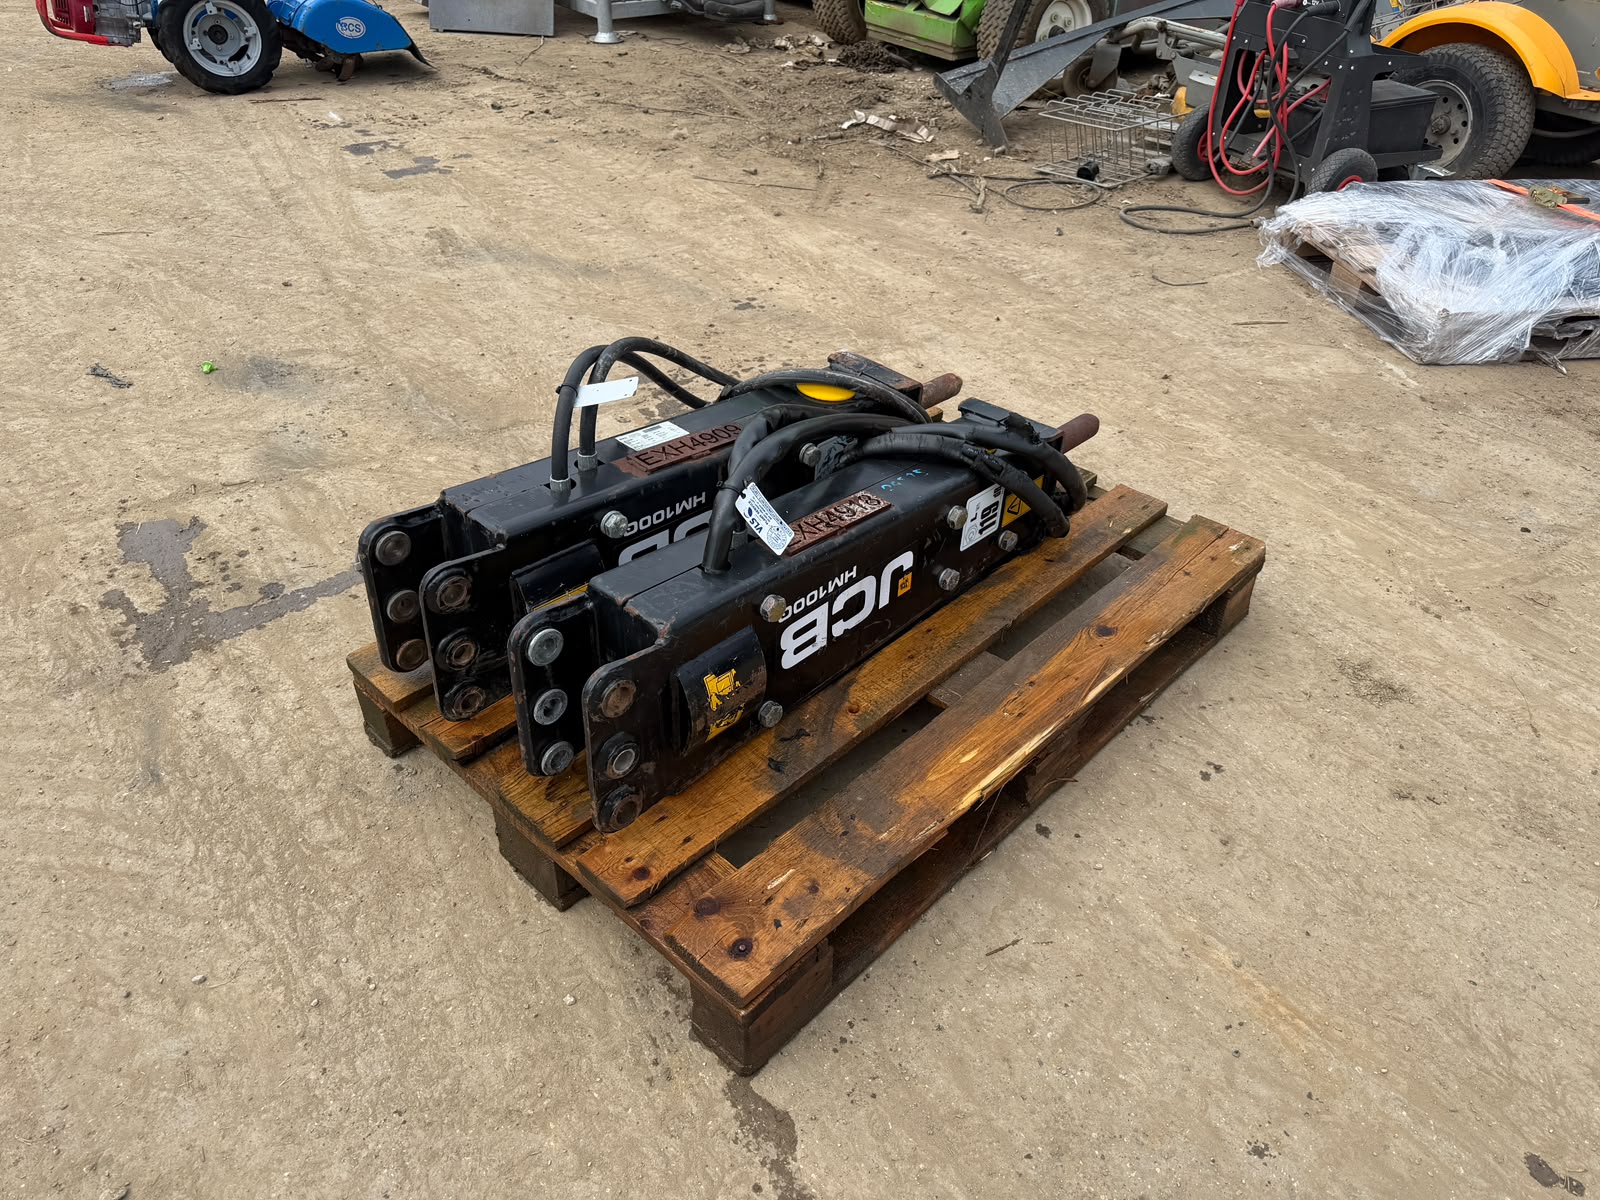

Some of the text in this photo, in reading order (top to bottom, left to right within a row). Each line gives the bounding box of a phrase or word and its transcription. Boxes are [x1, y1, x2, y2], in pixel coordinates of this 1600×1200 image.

[340, 22, 361, 33] BCS
[635, 424, 742, 466] EXH4909
[750, 517, 763, 533] VLS
[979, 500, 999, 535] 119
[780, 551, 914, 669] JCB
